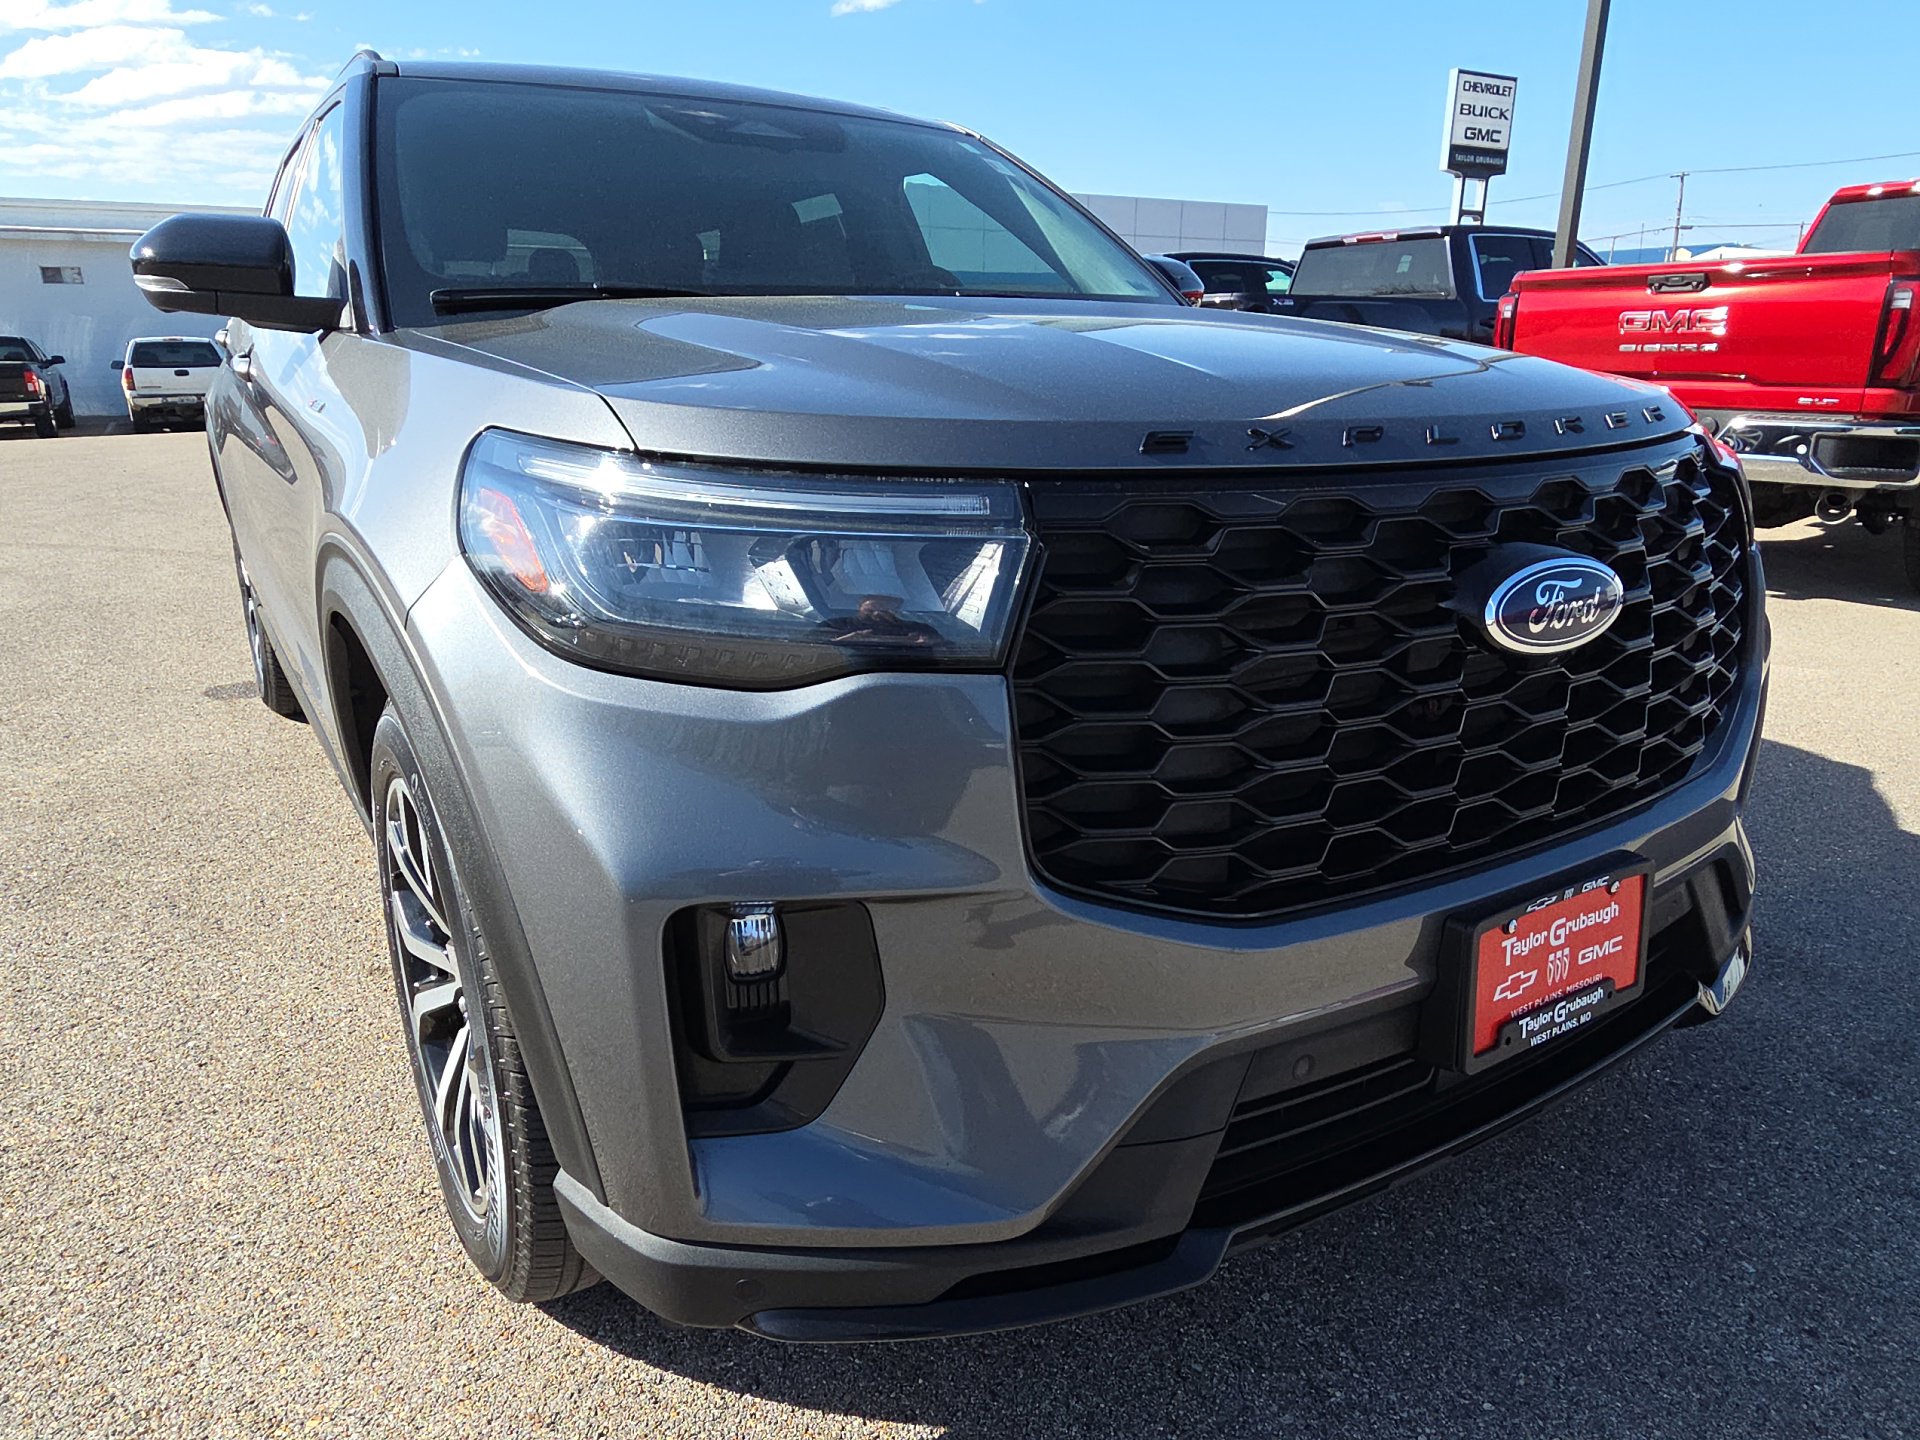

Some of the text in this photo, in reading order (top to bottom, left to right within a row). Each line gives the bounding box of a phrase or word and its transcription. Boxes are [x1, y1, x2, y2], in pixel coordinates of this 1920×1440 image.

[1463, 80, 1512, 97] CHEVROLET
[1459, 103, 1509, 120] BUICK
[1464, 127, 1502, 143] GMC
[1455, 153, 1504, 165] TAYLOR GRUBAUGH
[1618, 306, 1729, 336] GMC
[1138, 404, 1667, 455] EXPLORER
[1528, 577, 1602, 634] Ford
[1581, 876, 1610, 893] GMC
[1501, 901, 1619, 967] Taylor Grubaugh
[1577, 935, 1623, 965] GMC
[1510, 1004, 1533, 1018] WEST
[1566, 972, 1603, 994] MISSOURI
[1518, 986, 1604, 1039] Taylor Grubaugh
[1530, 1031, 1552, 1047] WEST
[1579, 1011, 1592, 1024] MO
